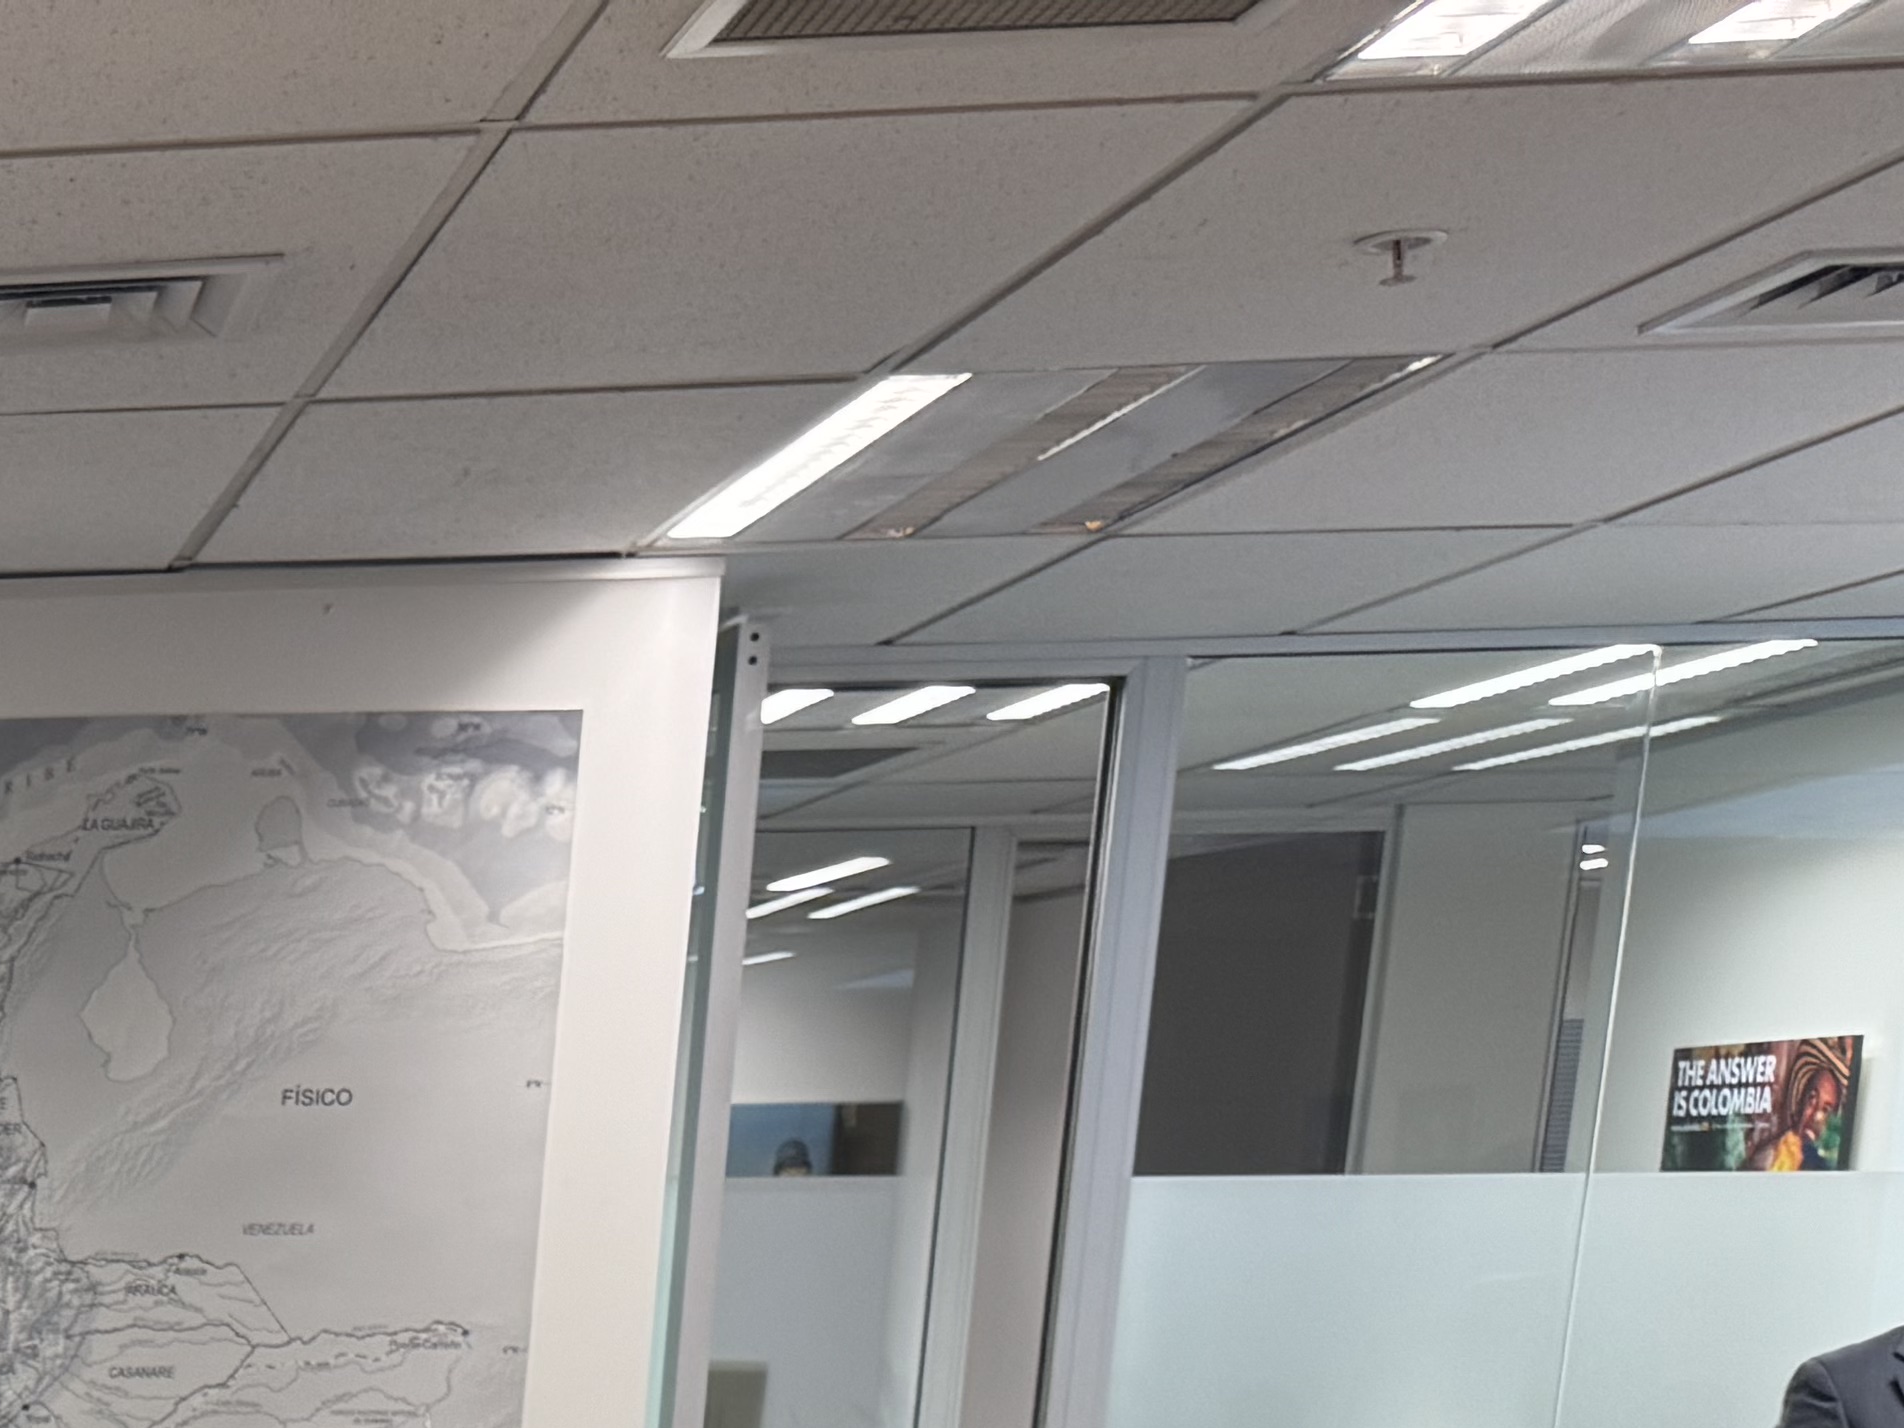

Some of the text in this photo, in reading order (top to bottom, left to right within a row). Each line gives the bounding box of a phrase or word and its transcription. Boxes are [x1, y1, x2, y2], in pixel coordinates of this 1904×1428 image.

[1677, 1054, 1777, 1087] THE ANSWER
[281, 1084, 354, 1108] FÍSICO
[1672, 1085, 1773, 1117] IS COLOMBIA
